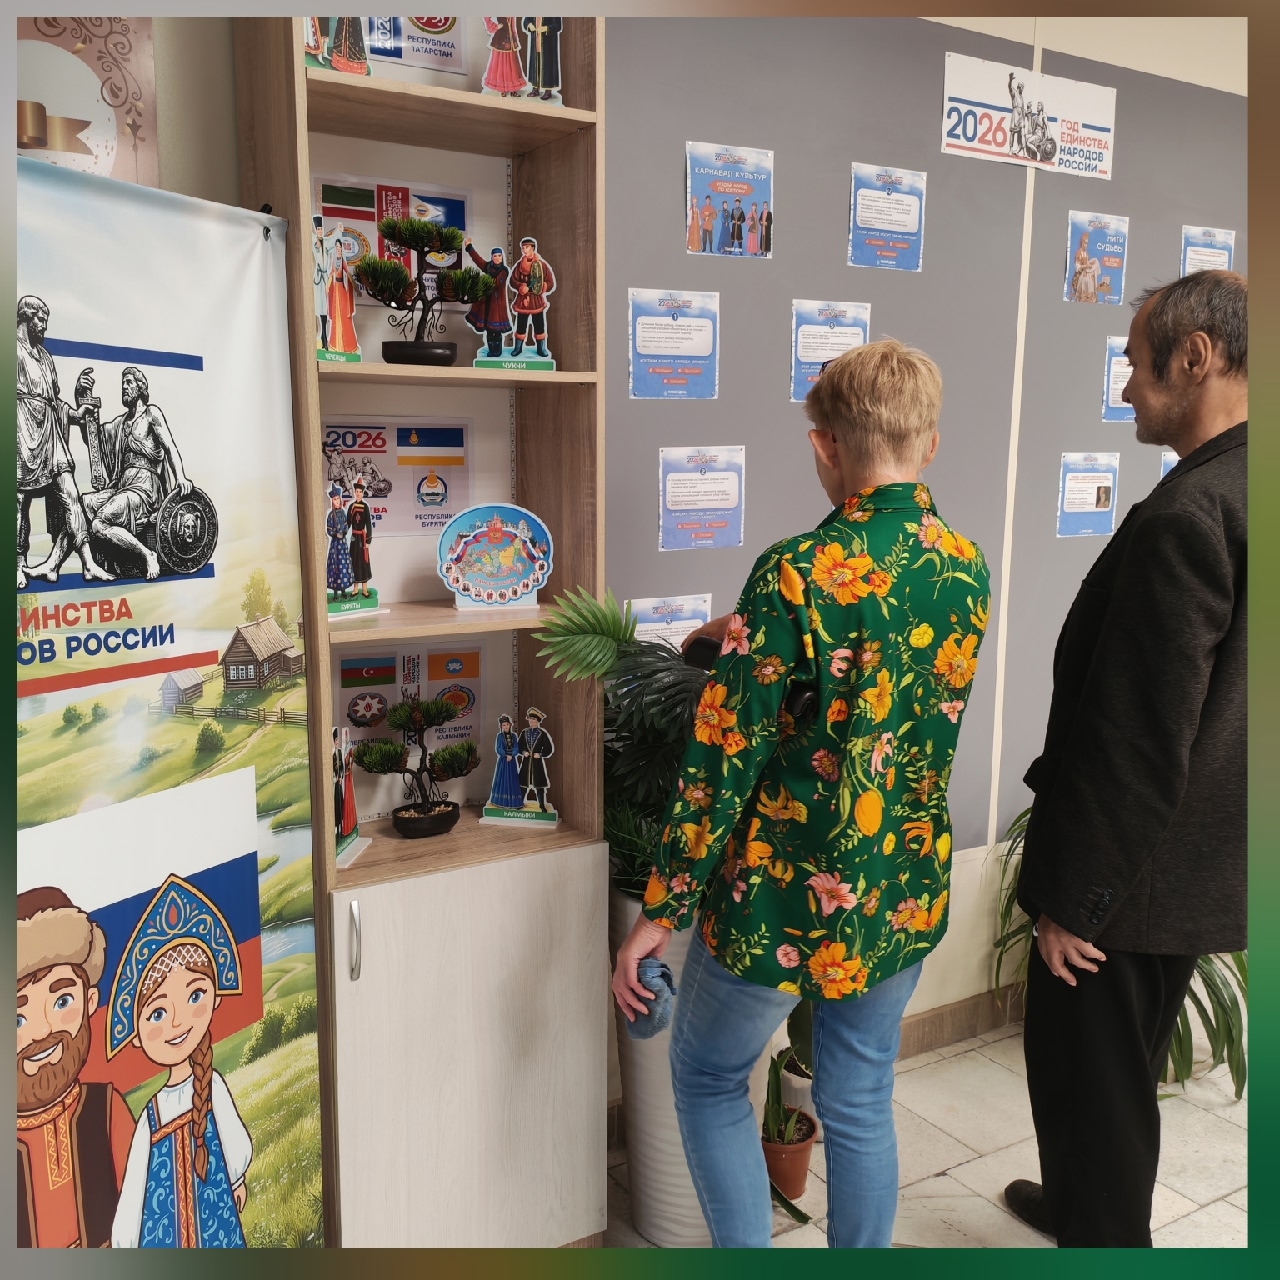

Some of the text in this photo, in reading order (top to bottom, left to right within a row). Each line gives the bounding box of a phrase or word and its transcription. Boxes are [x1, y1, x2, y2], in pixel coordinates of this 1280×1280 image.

[408, 35, 455, 49] РЕСПУБЛИКА
[412, 46, 452, 58] ТАТАРСТАН
[947, 106, 1007, 148] 2026
[1061, 119, 1078, 132] ГОД
[1061, 132, 1108, 151] ЕДИНСТВА
[1059, 145, 1103, 162] НАРОДОВ
[1058, 158, 1097, 172] РОССИИ
[326, 431, 387, 449] 2026
[341, 602, 361, 610] БУРЯТЫ
[17, 598, 133, 637] ИНСТВА
[66, 623, 174, 659] РОССИИ
